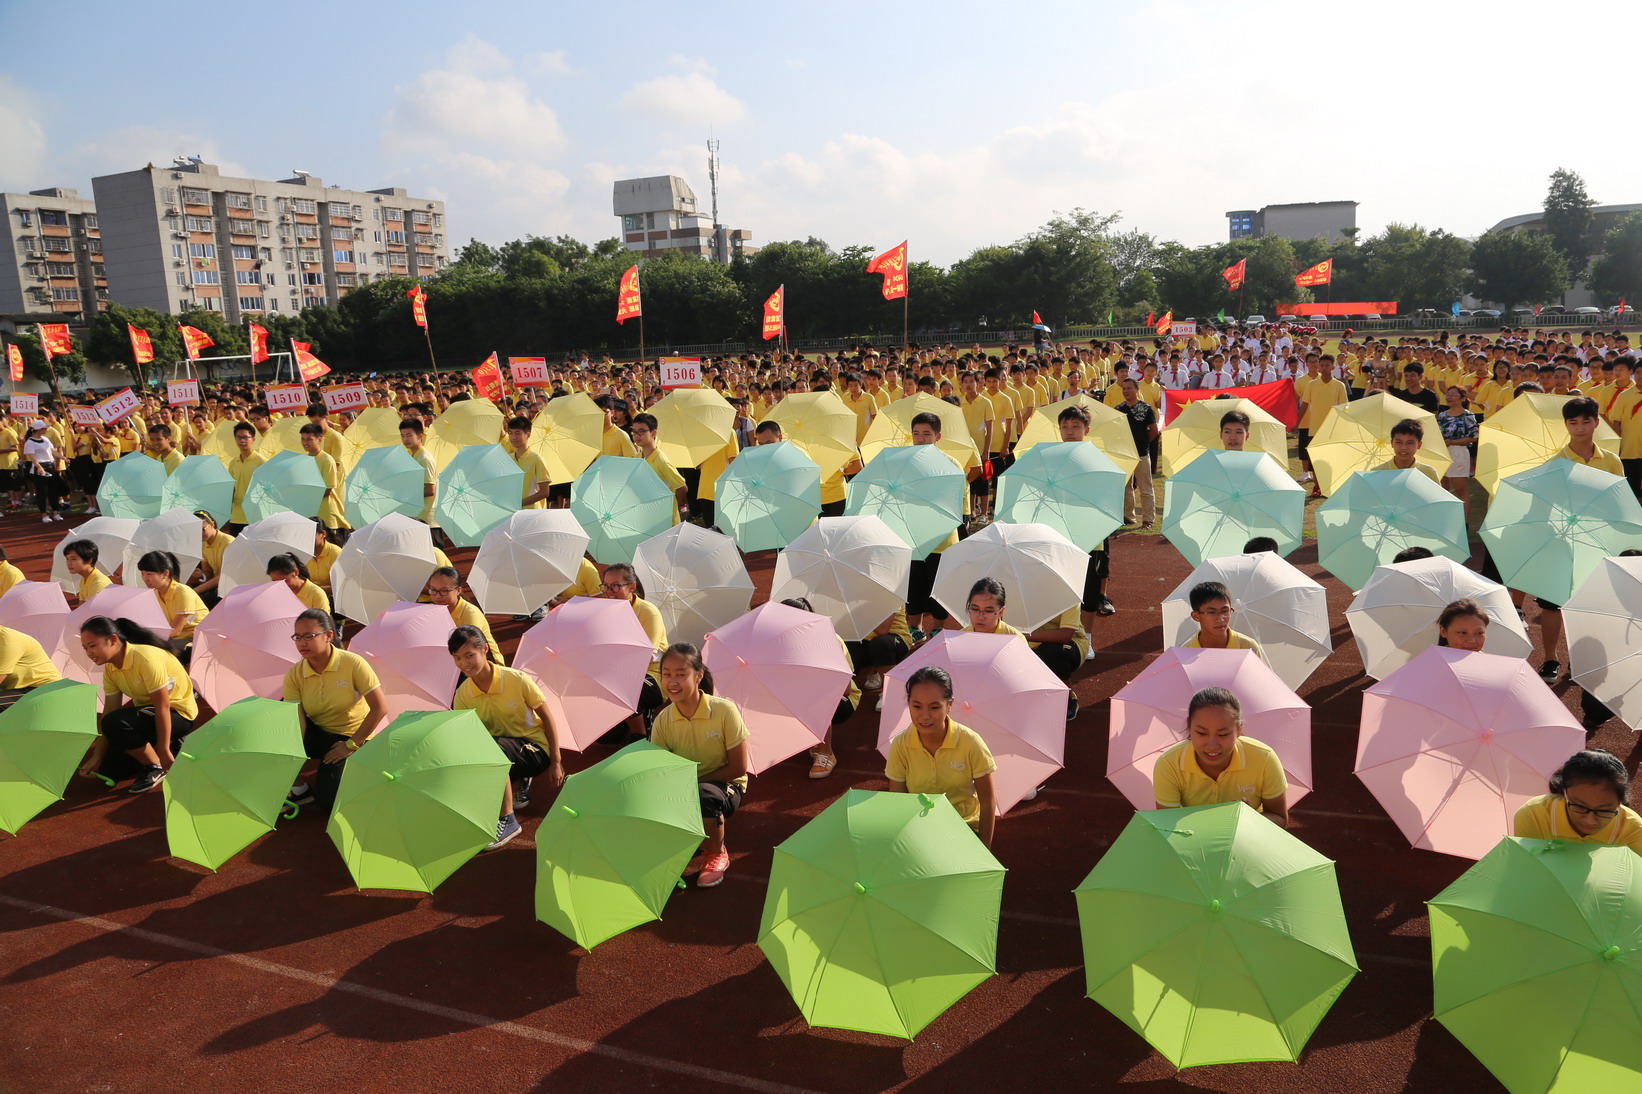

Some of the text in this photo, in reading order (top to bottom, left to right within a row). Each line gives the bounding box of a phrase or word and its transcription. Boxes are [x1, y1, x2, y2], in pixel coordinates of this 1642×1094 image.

[517, 367, 543, 378] 1507
[666, 367, 696, 380] 1506
[172, 388, 194, 398] 1511
[272, 392, 301, 405] 1510
[330, 391, 361, 405] 1509
[15, 400, 34, 410] 1514
[105, 396, 134, 417] 1512
[76, 412, 97, 422] 1513
